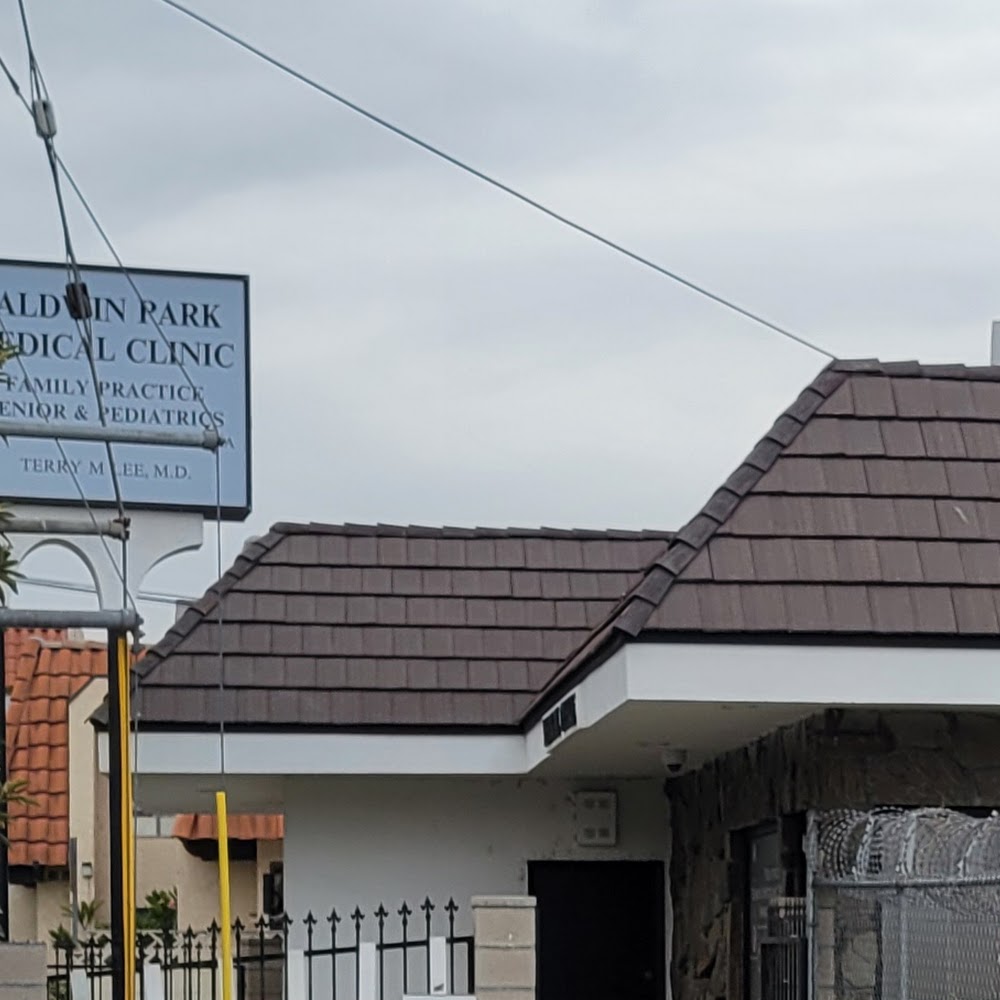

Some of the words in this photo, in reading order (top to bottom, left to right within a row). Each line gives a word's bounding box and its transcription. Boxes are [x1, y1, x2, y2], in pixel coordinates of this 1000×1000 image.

[0, 290, 126, 322] ALDIN
[139, 300, 222, 329] PARK
[126, 337, 235, 369] CLINIC
[6, 375, 89, 396] FAMILY
[100, 381, 204, 402] PRACTICE
[74, 404, 88, 421] &
[100, 406, 225, 428] PEDIATRICS
[20, 458, 82, 474] TERRY
[117, 464, 149, 480] EE,
[154, 465, 192, 481] M.D.
